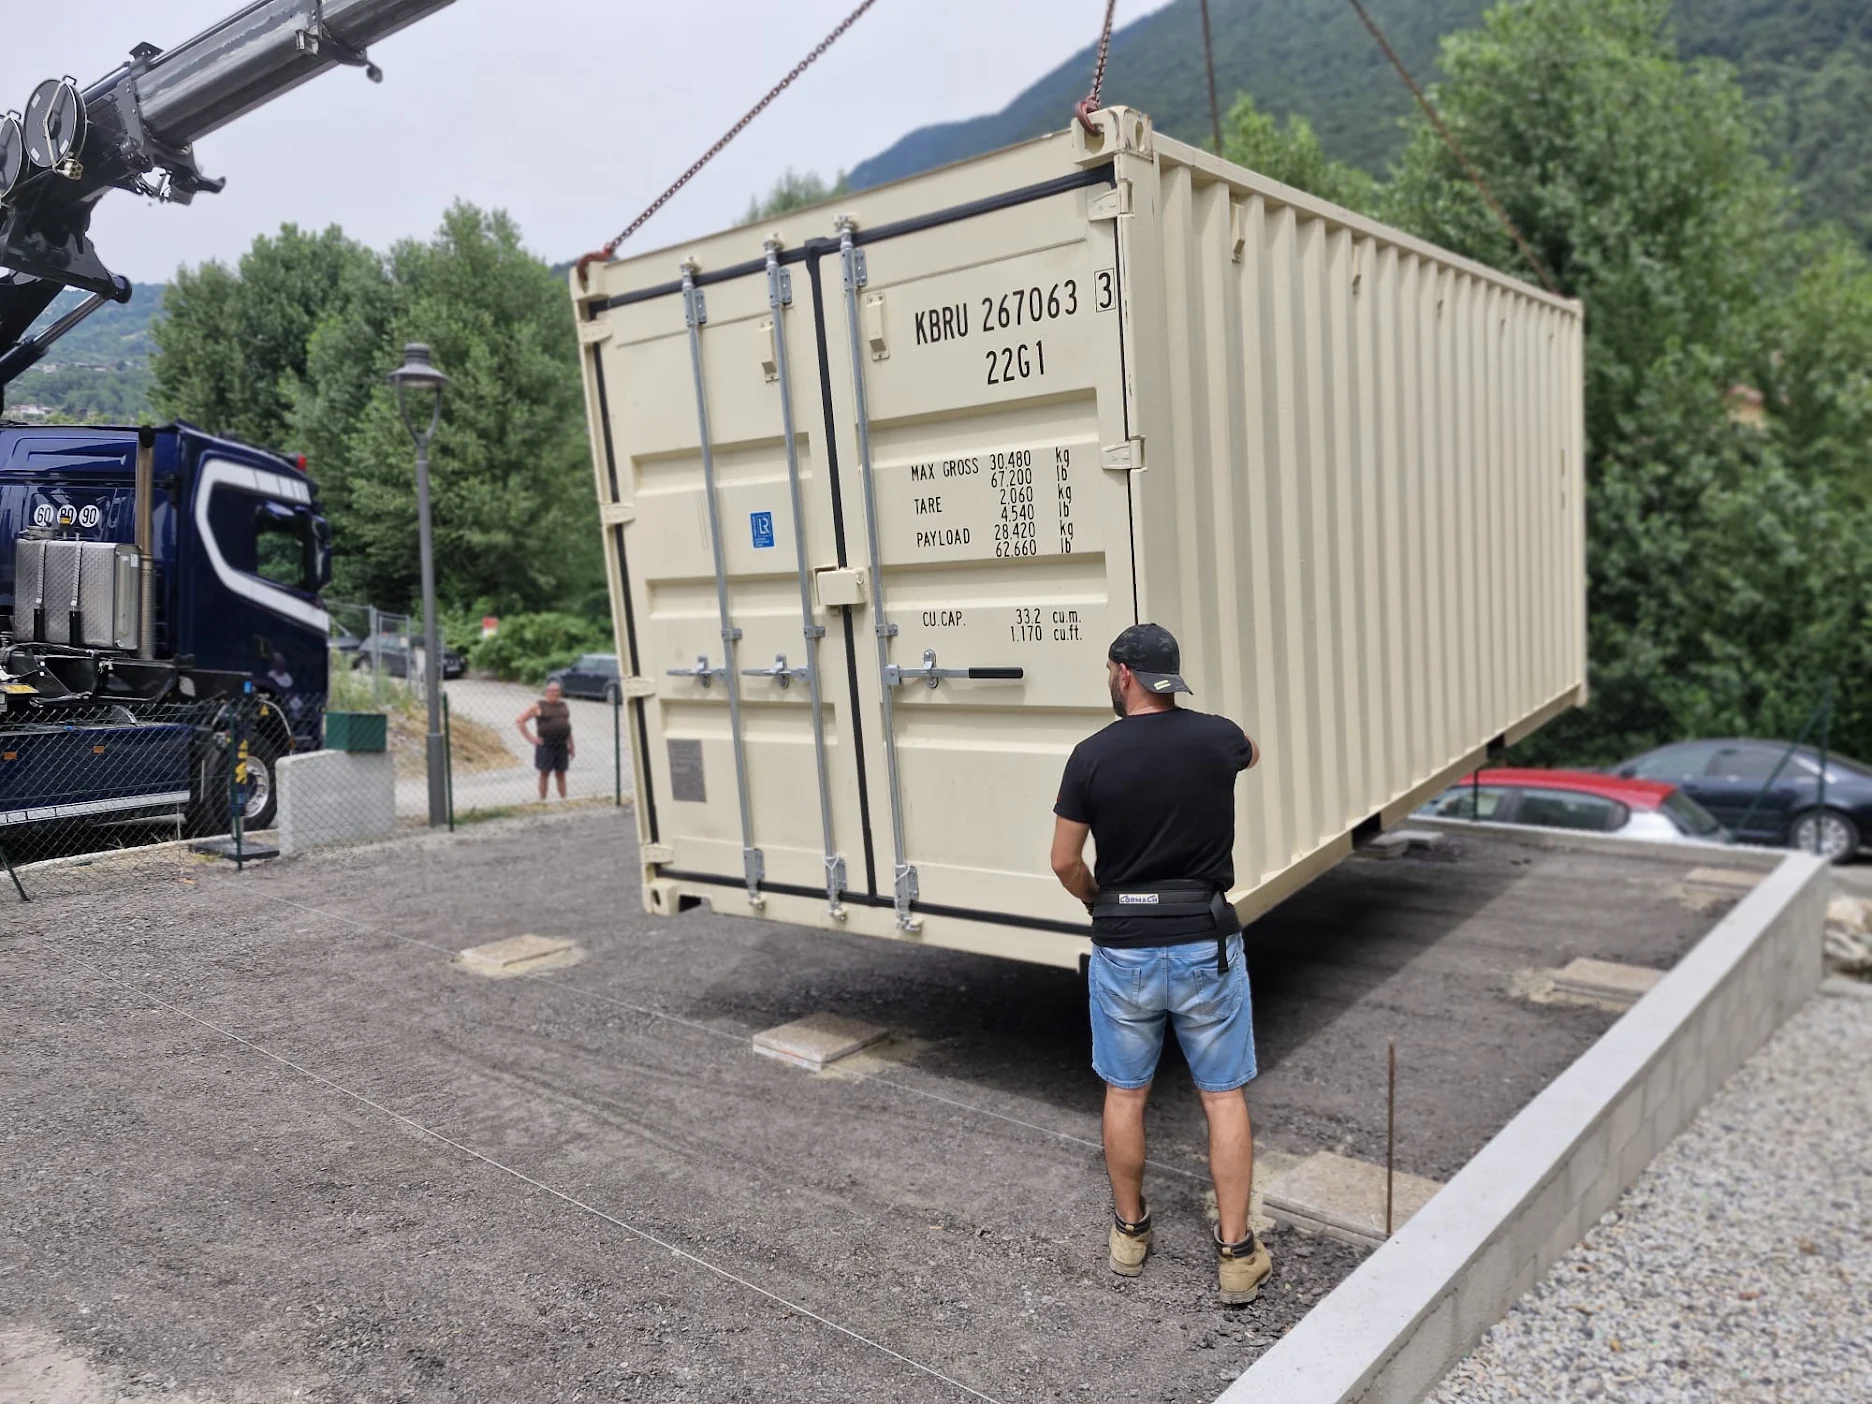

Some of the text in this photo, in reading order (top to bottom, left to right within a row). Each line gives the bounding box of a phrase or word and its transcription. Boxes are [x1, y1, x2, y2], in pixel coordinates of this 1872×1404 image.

[915, 272, 1112, 345] KBRU 267063 3
[985, 340, 1045, 385] 22G1
[911, 446, 1070, 481] MAX GROSS 30.480 kg
[991, 464, 1068, 488] 67.200 lb
[914, 483, 1072, 515] TARE 2.060 kg
[37, 507, 51, 523] 60
[83, 508, 97, 524] 90
[1001, 501, 1070, 522] 4.540 lb
[916, 519, 1074, 548] PAYLOAD 28.420 kg
[995, 537, 1071, 558] 62.660 lb
[922, 608, 1082, 627] CU.CAP. 33.2 cu.m.
[1010, 624, 1083, 643] 1.170 cu.ft.
